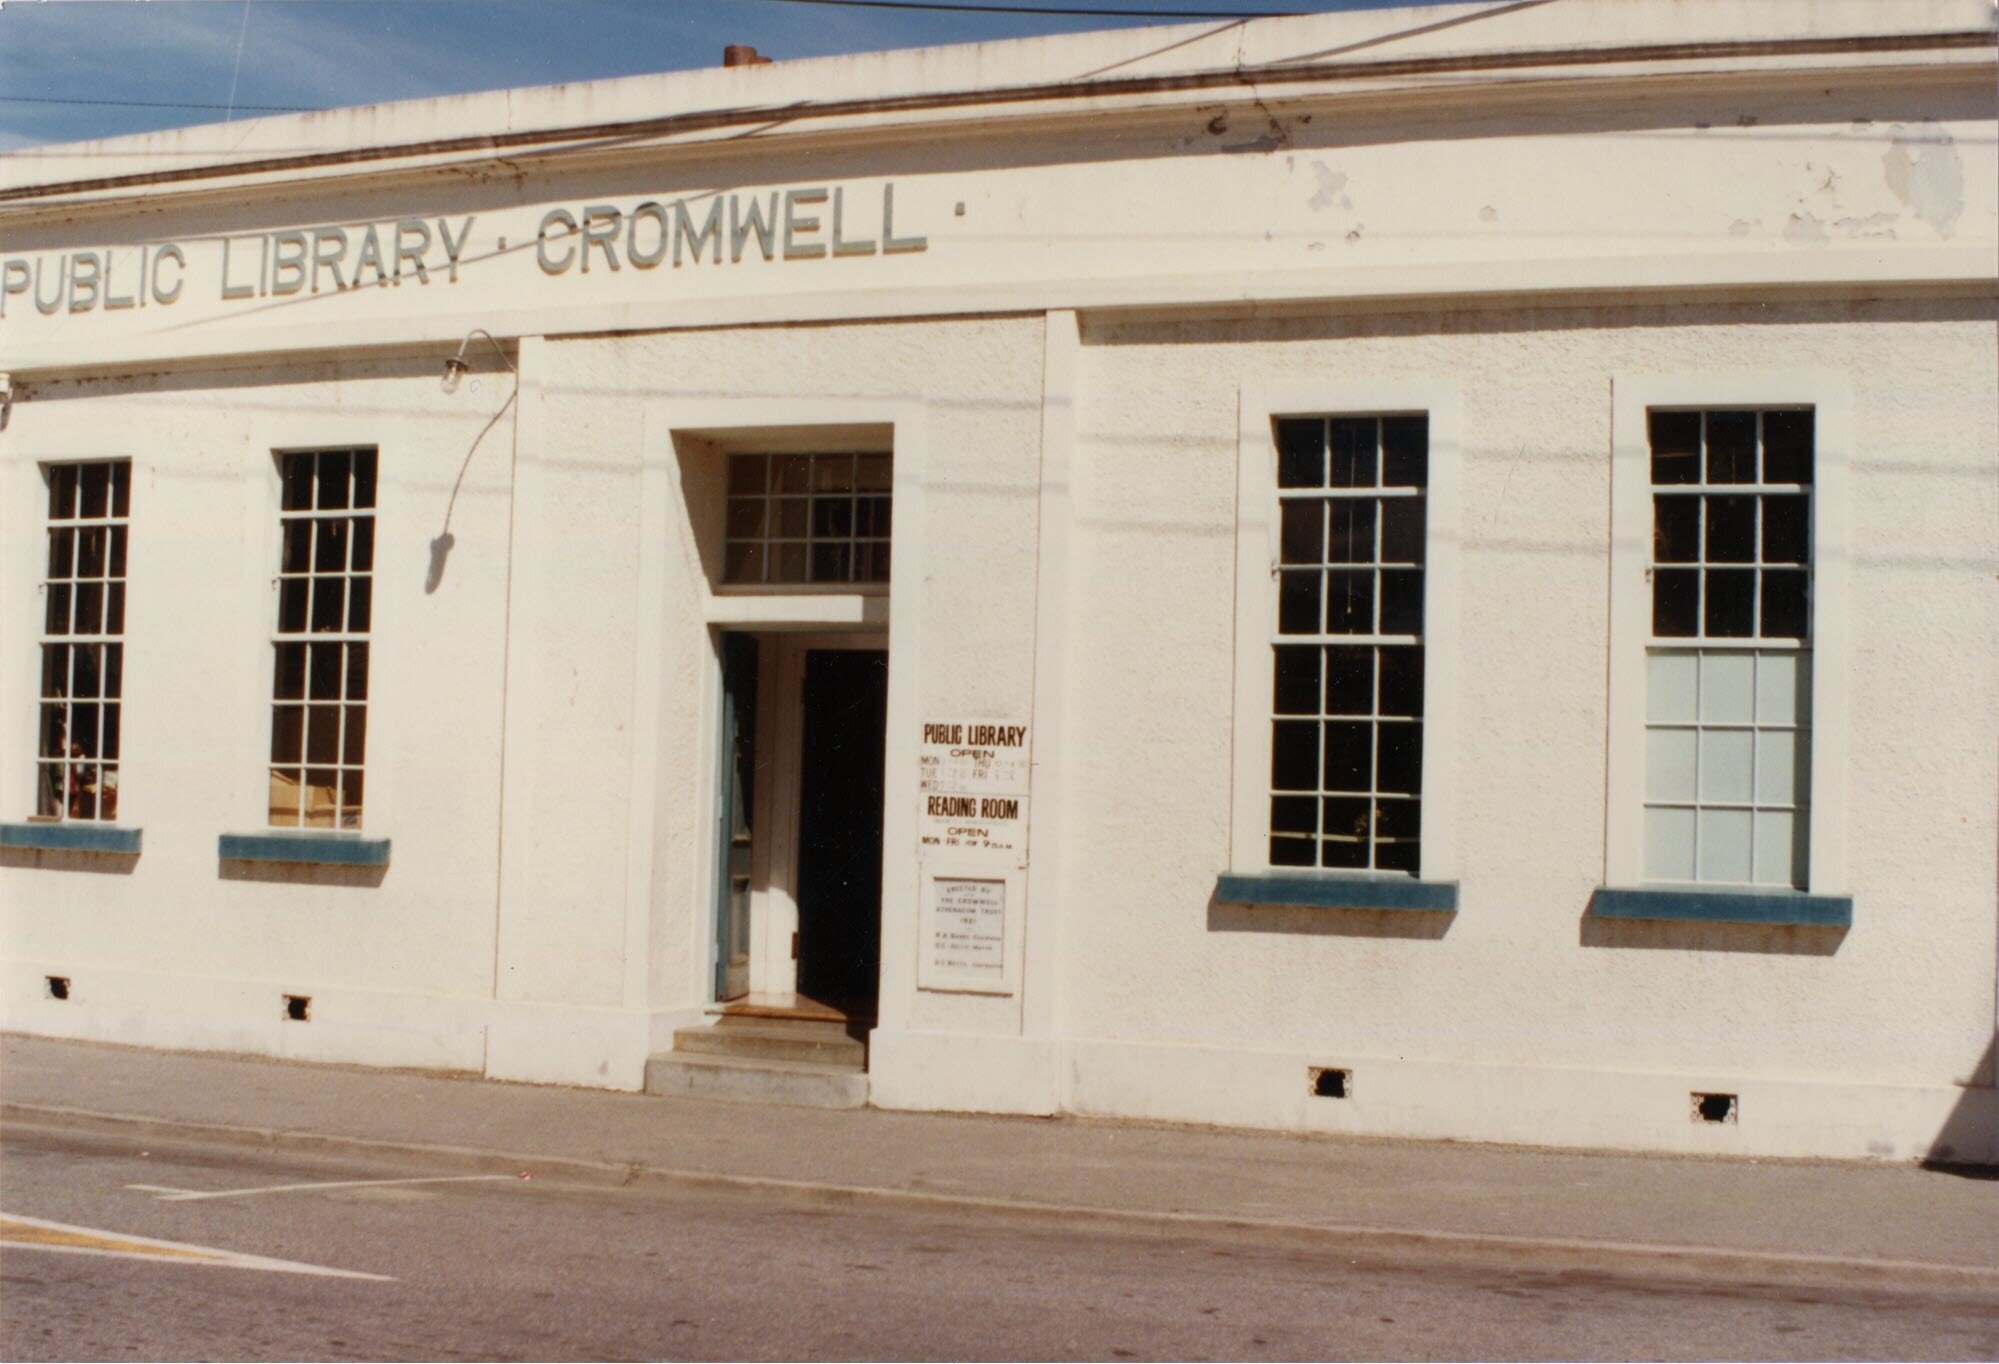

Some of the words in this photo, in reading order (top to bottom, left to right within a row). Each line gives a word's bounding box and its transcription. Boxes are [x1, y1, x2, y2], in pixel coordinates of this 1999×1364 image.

[0, 243, 186, 318] PUBLIC
[221, 216, 476, 301] LIBRARY
[536, 182, 928, 276] CROMWELL
[923, 723, 963, 745] PUBLIC
[968, 725, 1026, 748] LIBRARY
[950, 748, 996, 760] OPEN
[927, 795, 977, 818] READING
[980, 798, 1018, 820] ROOM
[947, 826, 989, 838] OPEN
